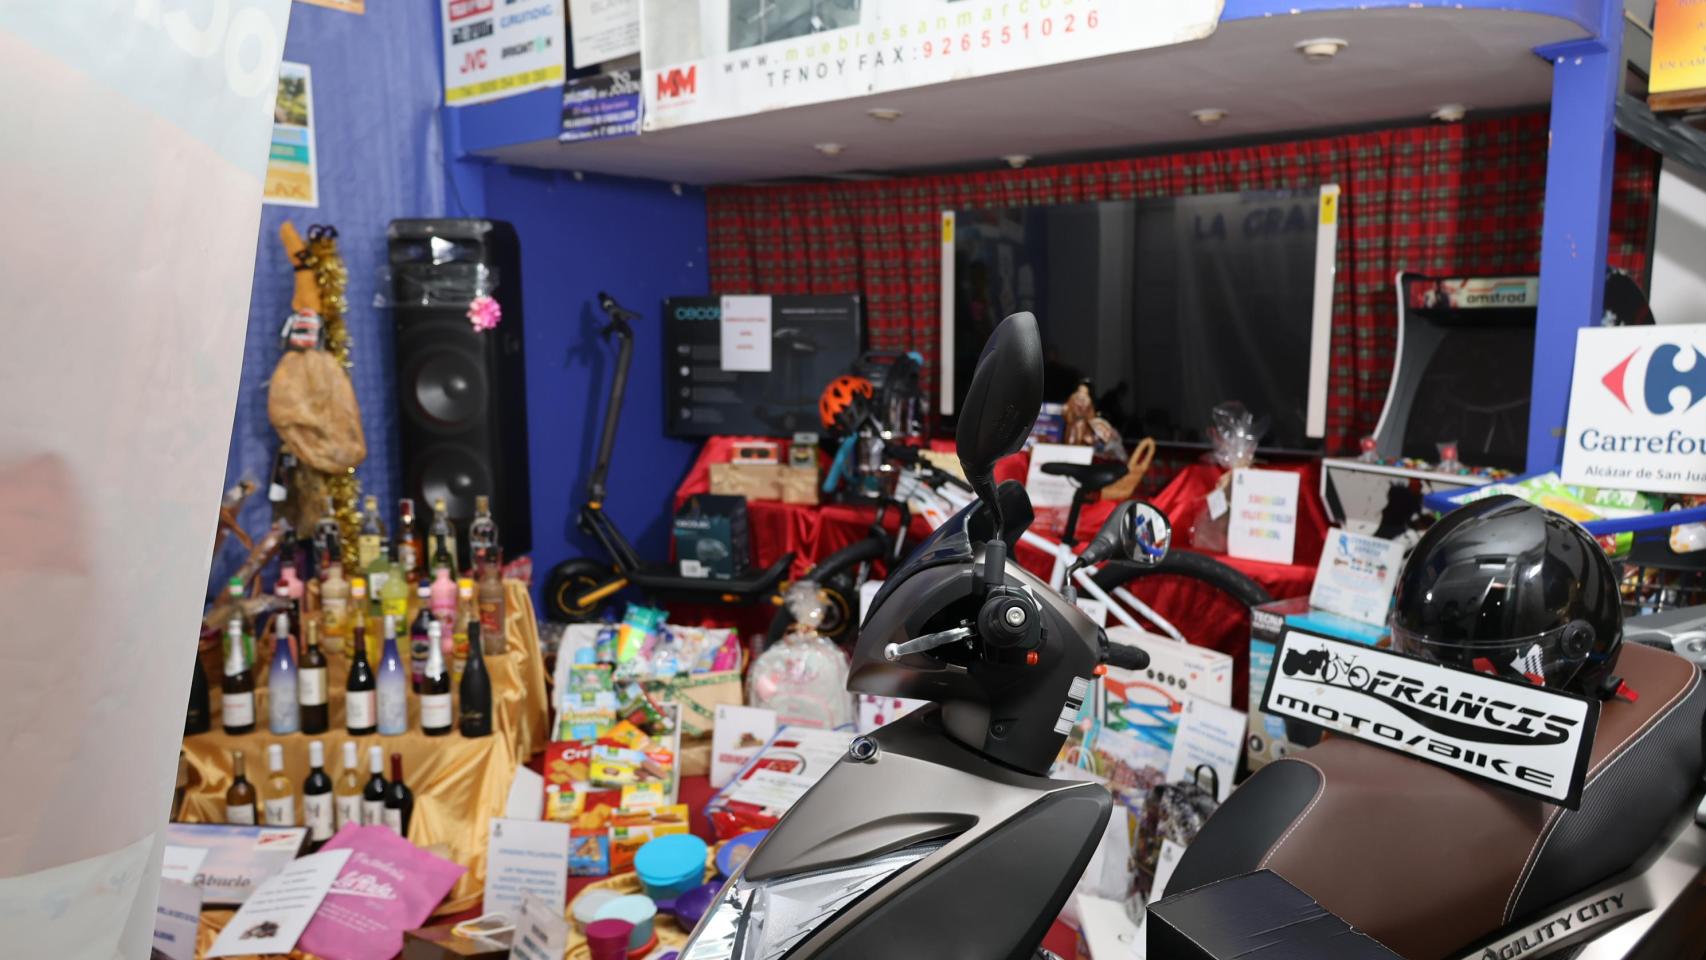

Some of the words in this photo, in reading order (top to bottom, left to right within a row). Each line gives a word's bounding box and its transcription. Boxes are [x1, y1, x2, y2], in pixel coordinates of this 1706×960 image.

[459, 48, 487, 75] JVC
[1466, 289, 1527, 305] amstrad
[1585, 465, 1632, 479] Alcázar
[1636, 467, 1653, 480] de
[1657, 468, 1682, 481] San
[1365, 669, 1579, 740] FRANCIS
[1482, 912, 1573, 960] AGILITY
[1576, 893, 1624, 923] CITY
